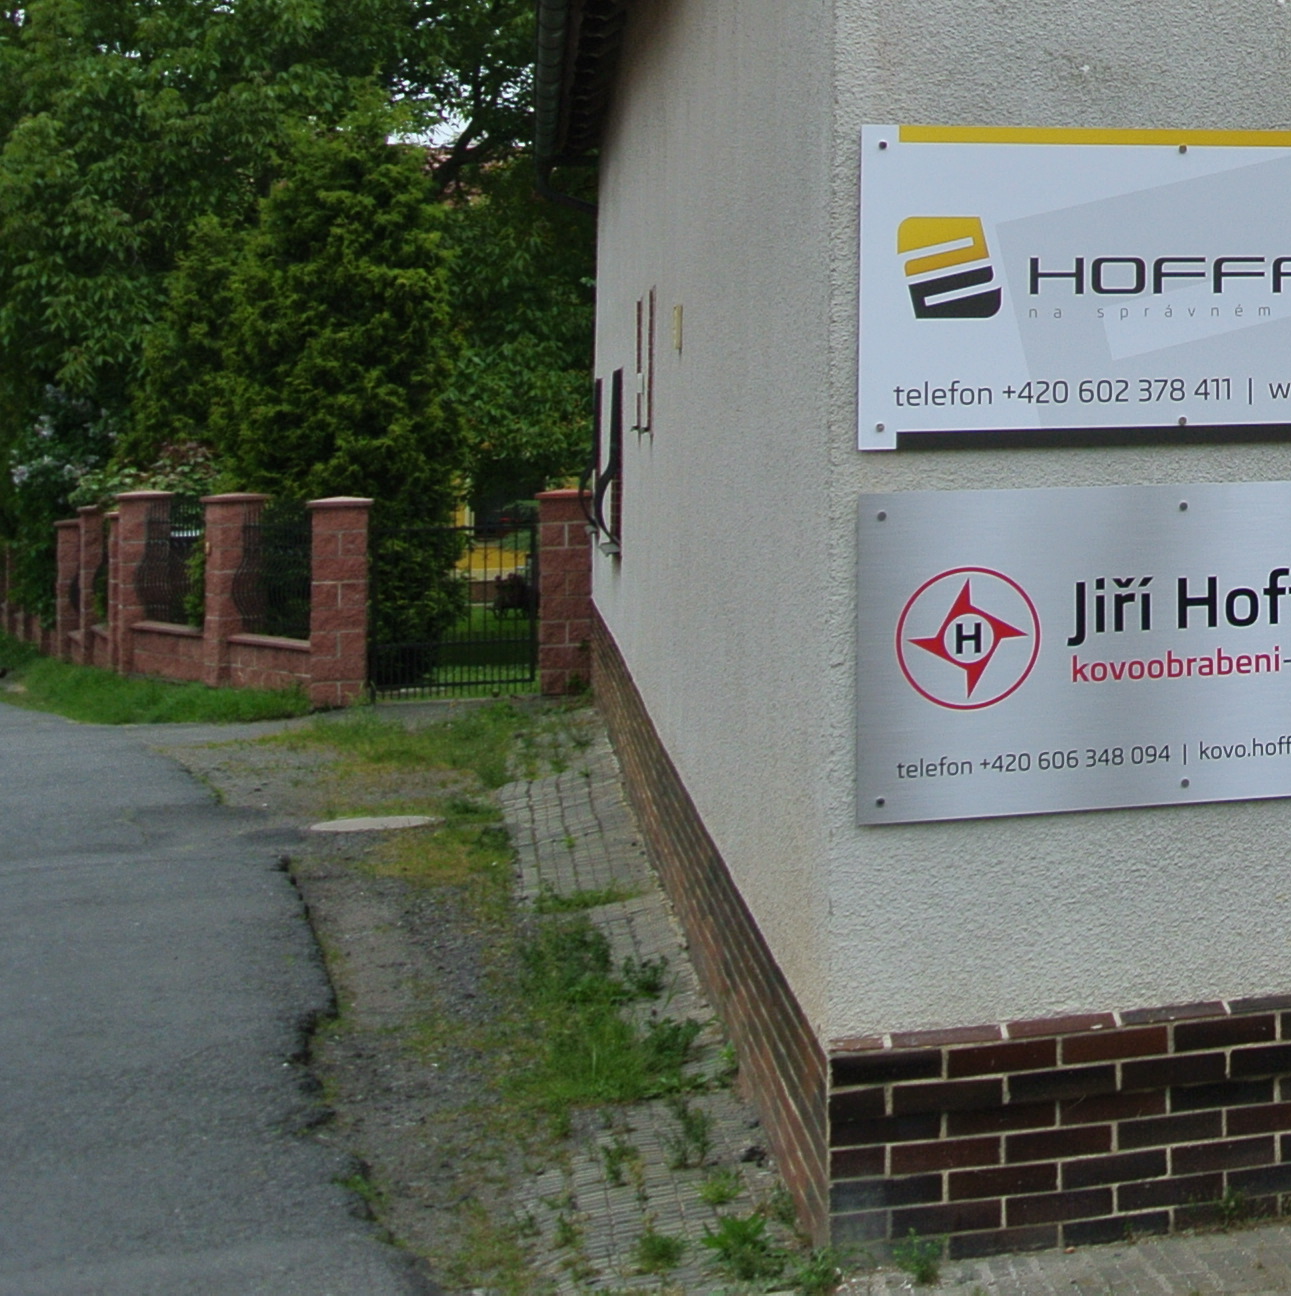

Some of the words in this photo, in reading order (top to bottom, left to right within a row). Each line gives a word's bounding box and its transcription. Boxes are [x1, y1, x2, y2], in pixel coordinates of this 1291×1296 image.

[1029, 307, 1062, 319] na
[1097, 304, 1271, 321] správném
[893, 380, 993, 407] telefon
[1002, 380, 1069, 404] +420
[1078, 379, 1129, 403] 602
[1138, 378, 1185, 402] 378
[1194, 378, 1231, 401] 411
[1066, 576, 1154, 647] Jiří
[955, 623, 982, 655] H
[896, 756, 973, 779] telefon
[979, 753, 1031, 773] +420
[1038, 750, 1079, 770] 606
[1085, 747, 1124, 768] 348
[1130, 744, 1171, 765] 094
